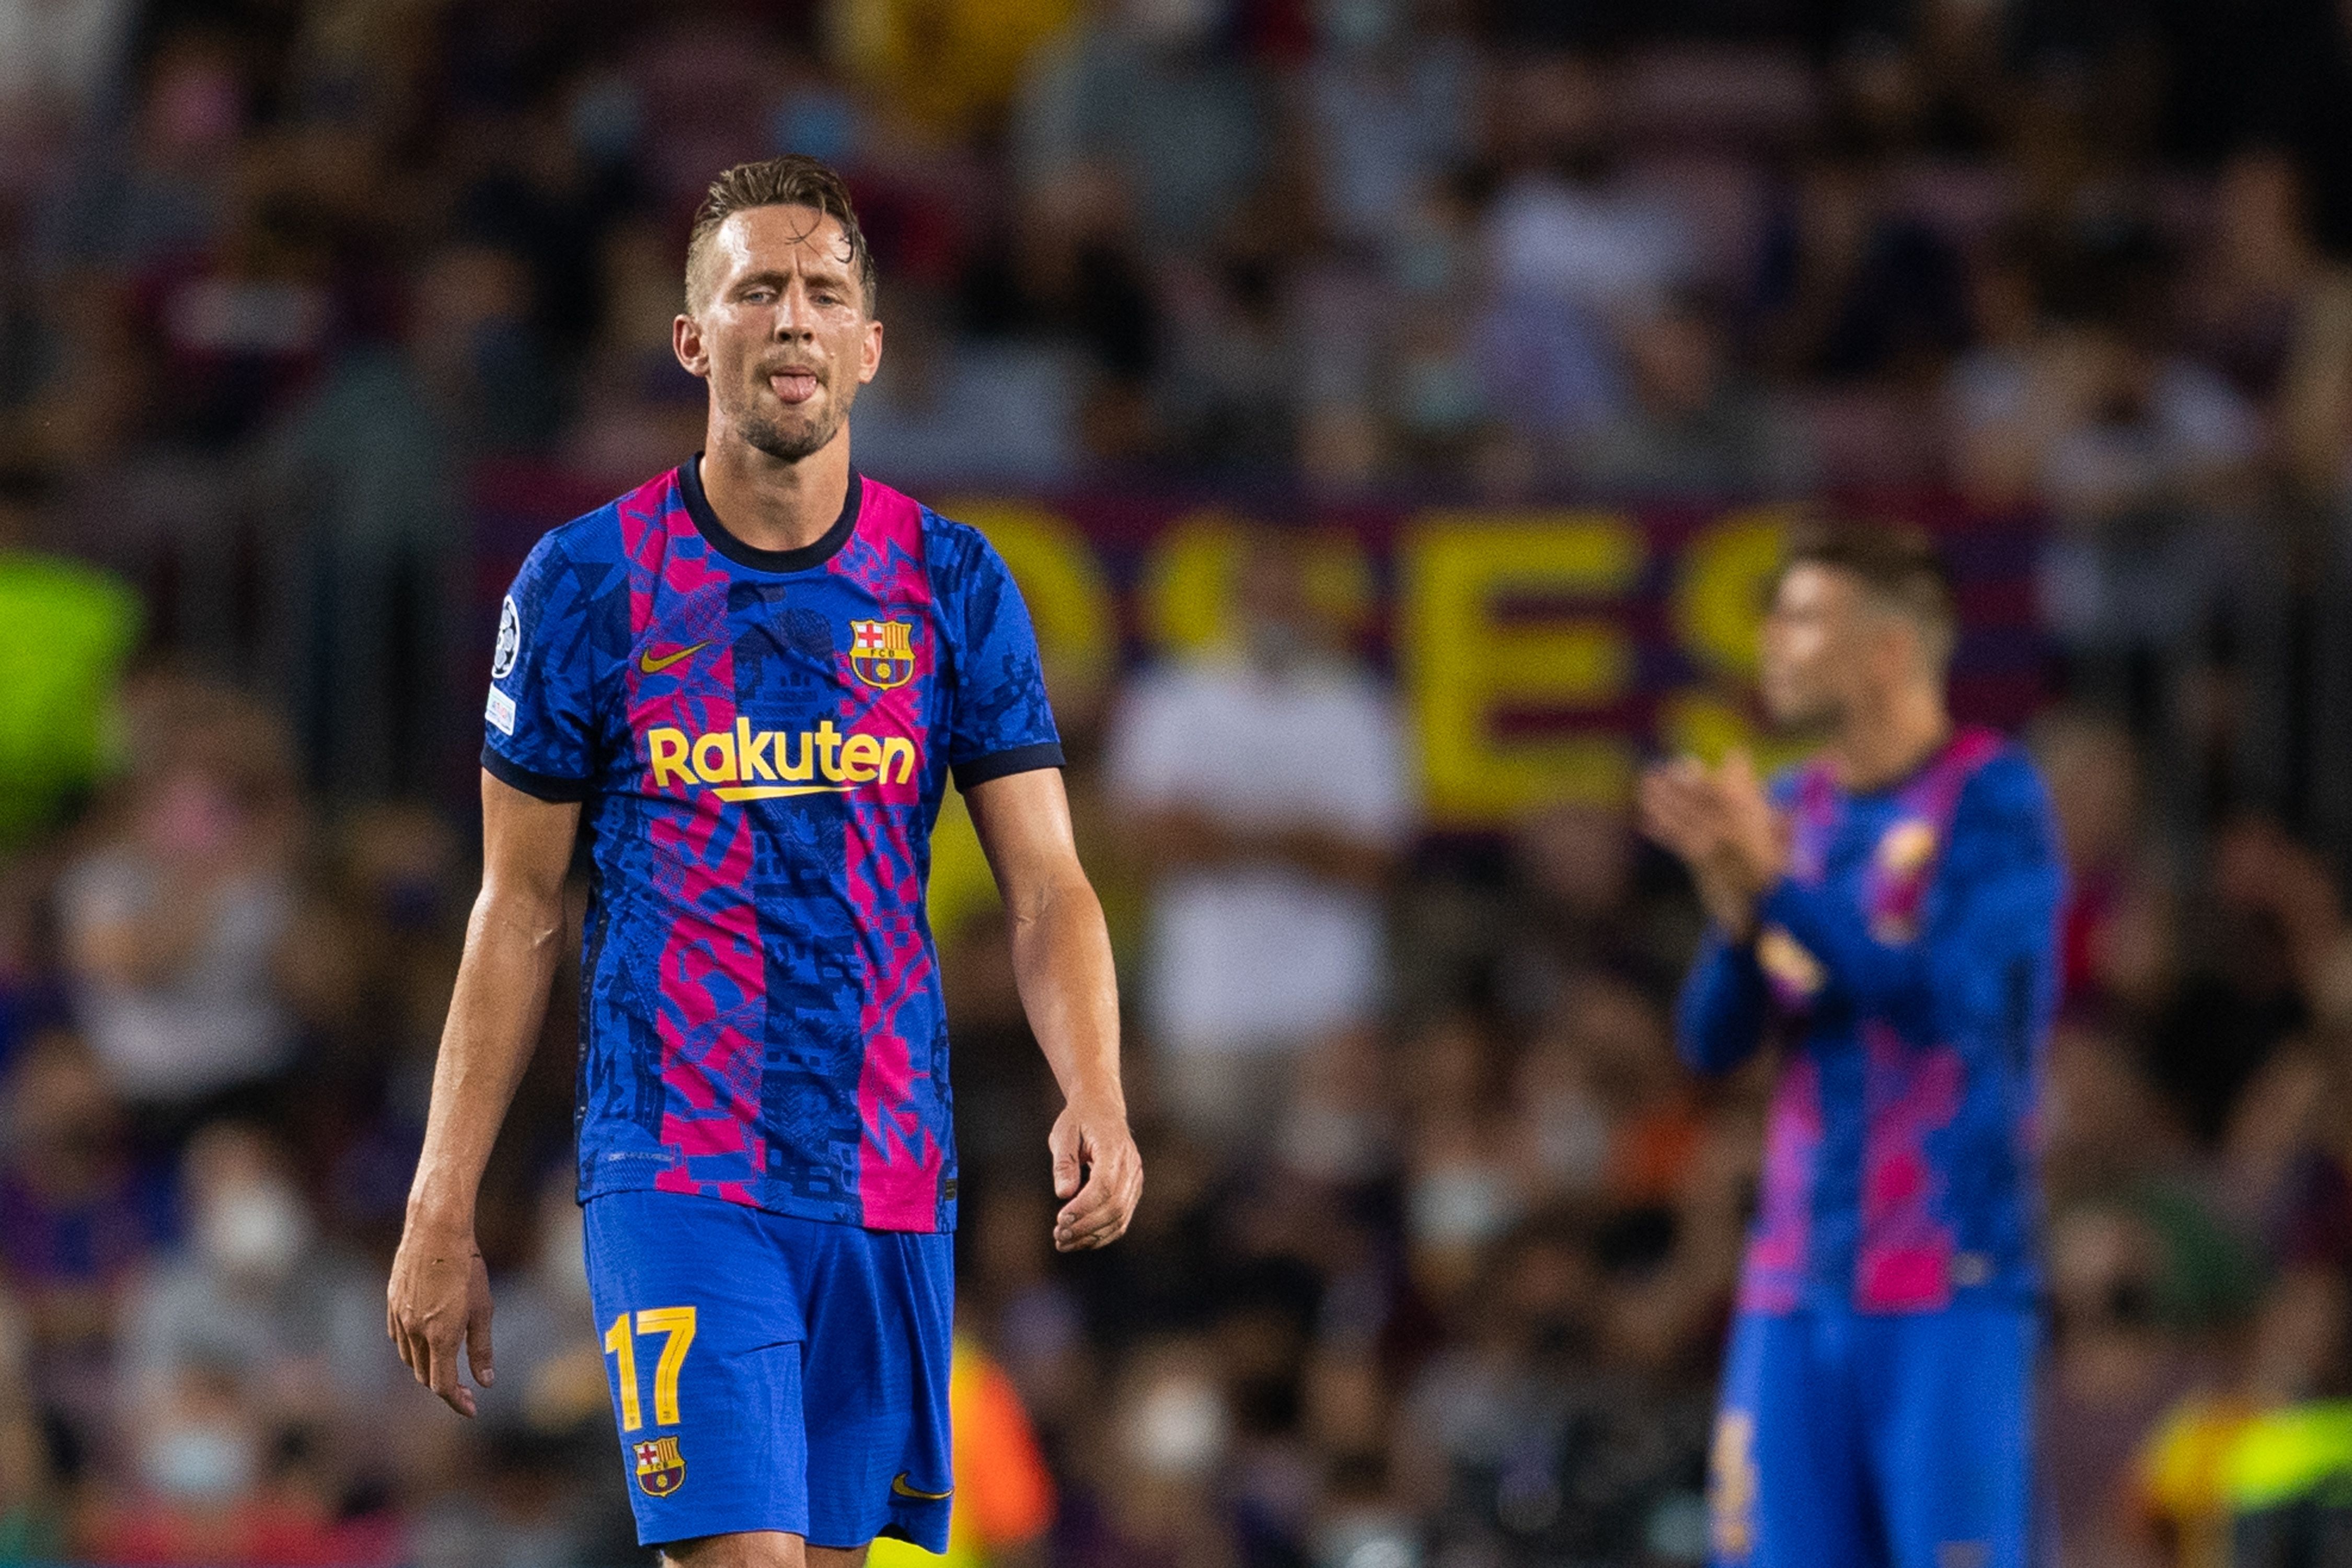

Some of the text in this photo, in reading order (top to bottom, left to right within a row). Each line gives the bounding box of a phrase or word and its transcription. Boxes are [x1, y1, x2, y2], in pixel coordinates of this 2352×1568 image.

[870, 649, 895, 658] FCB
[648, 716, 915, 787] Rakuten
[605, 1306, 697, 1432] 17
